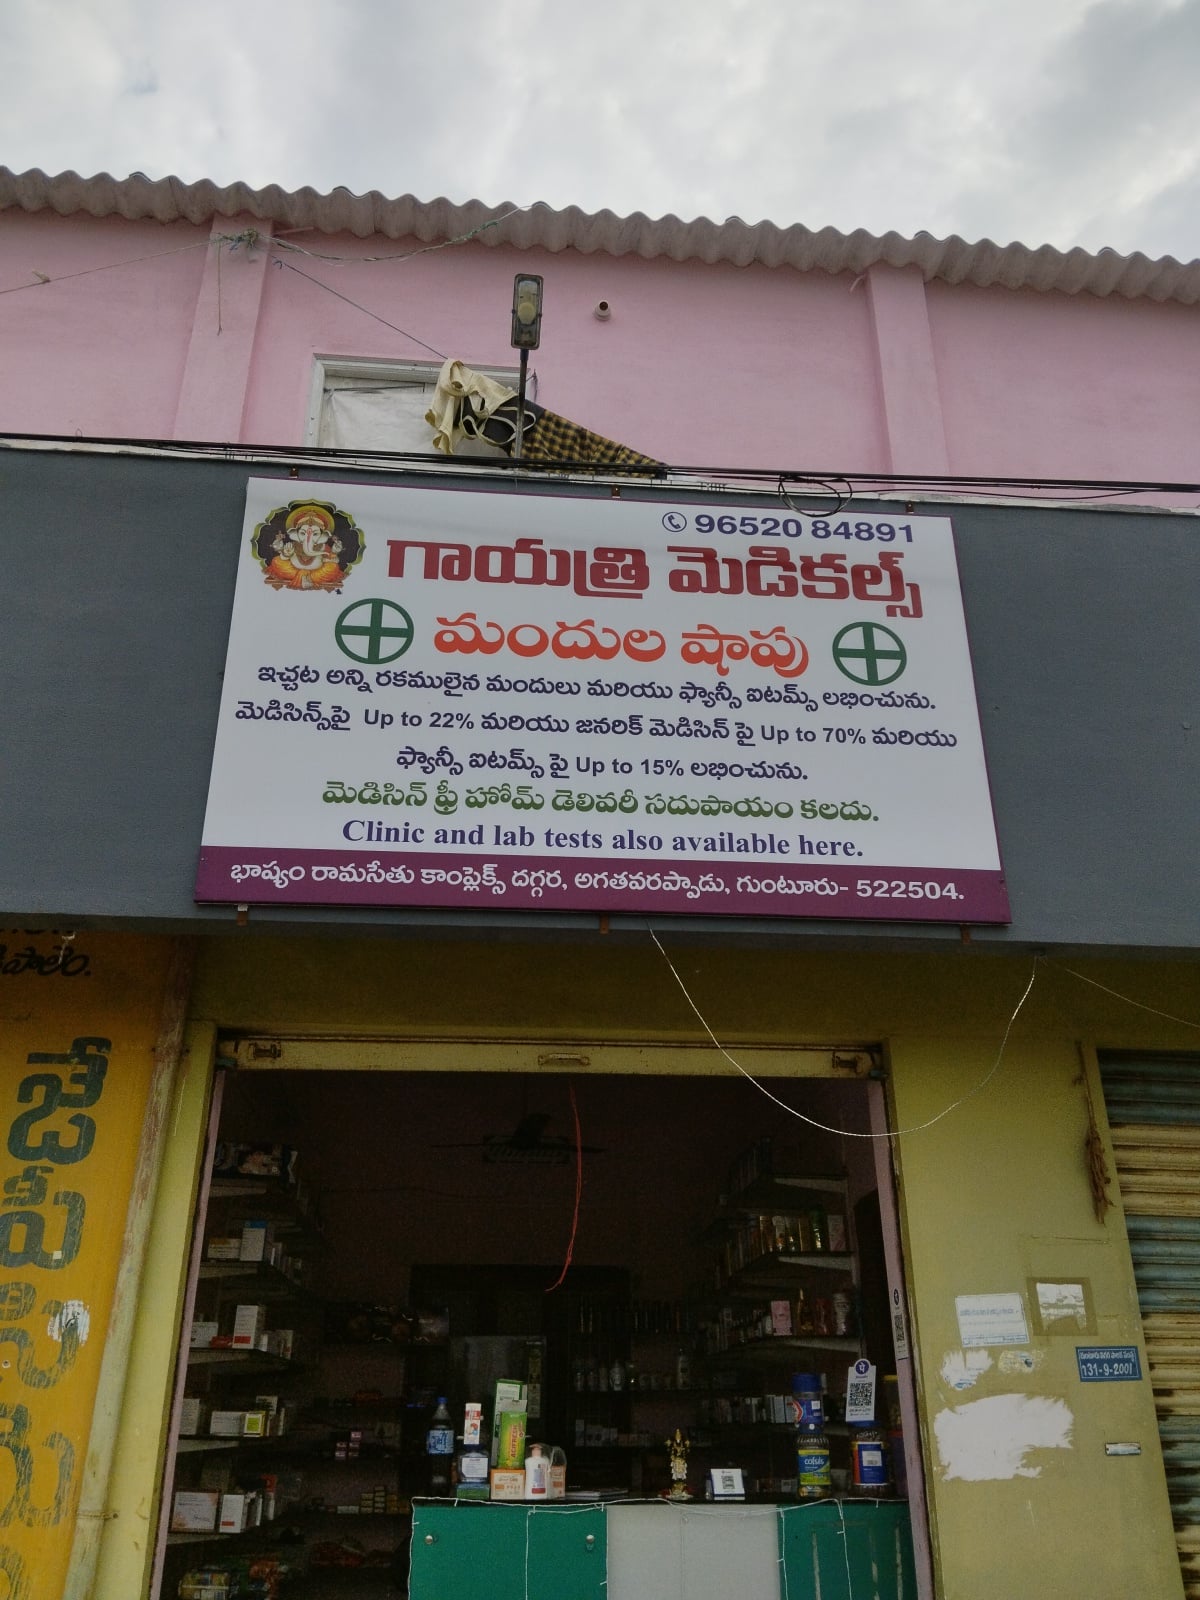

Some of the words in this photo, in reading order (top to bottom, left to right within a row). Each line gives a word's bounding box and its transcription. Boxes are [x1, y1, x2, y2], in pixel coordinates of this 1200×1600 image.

[695, 514, 802, 538] 96520
[811, 519, 914, 543] 84891
[387, 538, 649, 599] గాయత్రి
[667, 546, 923, 618] మెడికల్స్
[434, 612, 666, 662] మందుల
[681, 624, 809, 678] షాపు
[258, 665, 320, 691] ఇచ్చట
[326, 669, 373, 693] అన్ని
[376, 670, 480, 697] రకములైన
[486, 675, 581, 695] మందులు
[587, 679, 673, 699] మరియు
[679, 681, 742, 709] ఫ్యాన్సీ
[747, 684, 818, 712] ఐటమ్స్
[823, 691, 936, 709] లభించును.
[365, 709, 393, 729] Up
[401, 712, 422, 727] to
[429, 712, 474, 729] 22%
[481, 712, 569, 732] మరియు
[576, 715, 643, 735] జనరిక్
[649, 717, 729, 738] మెడిసిన్
[735, 722, 756, 746] పై
[761, 725, 789, 744] Up
[796, 727, 816, 742] to
[823, 728, 866, 744] 70%
[872, 727, 957, 747] మరియు
[397, 746, 463, 775] ఫ్యాన్సీ
[469, 748, 544, 778] ఐటమ్స్
[549, 753, 570, 779] పై
[576, 757, 605, 776] Up
[612, 758, 633, 774] to
[641, 759, 684, 776] 15%
[691, 761, 808, 780] లభించును.
[322, 781, 427, 806] మెడిసిన్
[434, 780, 458, 815] ఫ్రీ
[465, 783, 544, 810] హోమ్
[552, 789, 638, 813] డెలివరీ
[644, 793, 793, 818] సదుపాయం
[800, 799, 879, 821] కలదు.
[343, 820, 424, 843] Clinic
[434, 825, 484, 844] and
[494, 825, 534, 846] lab
[545, 828, 602, 848] tests
[612, 830, 662, 850] also
[672, 832, 790, 853] available
[798, 835, 862, 856] here.
[231, 861, 305, 888] భాష్యం
[312, 861, 414, 883] రామసేతు
[512, 870, 567, 897] దగ్గర,
[857, 880, 964, 899] 522504.
